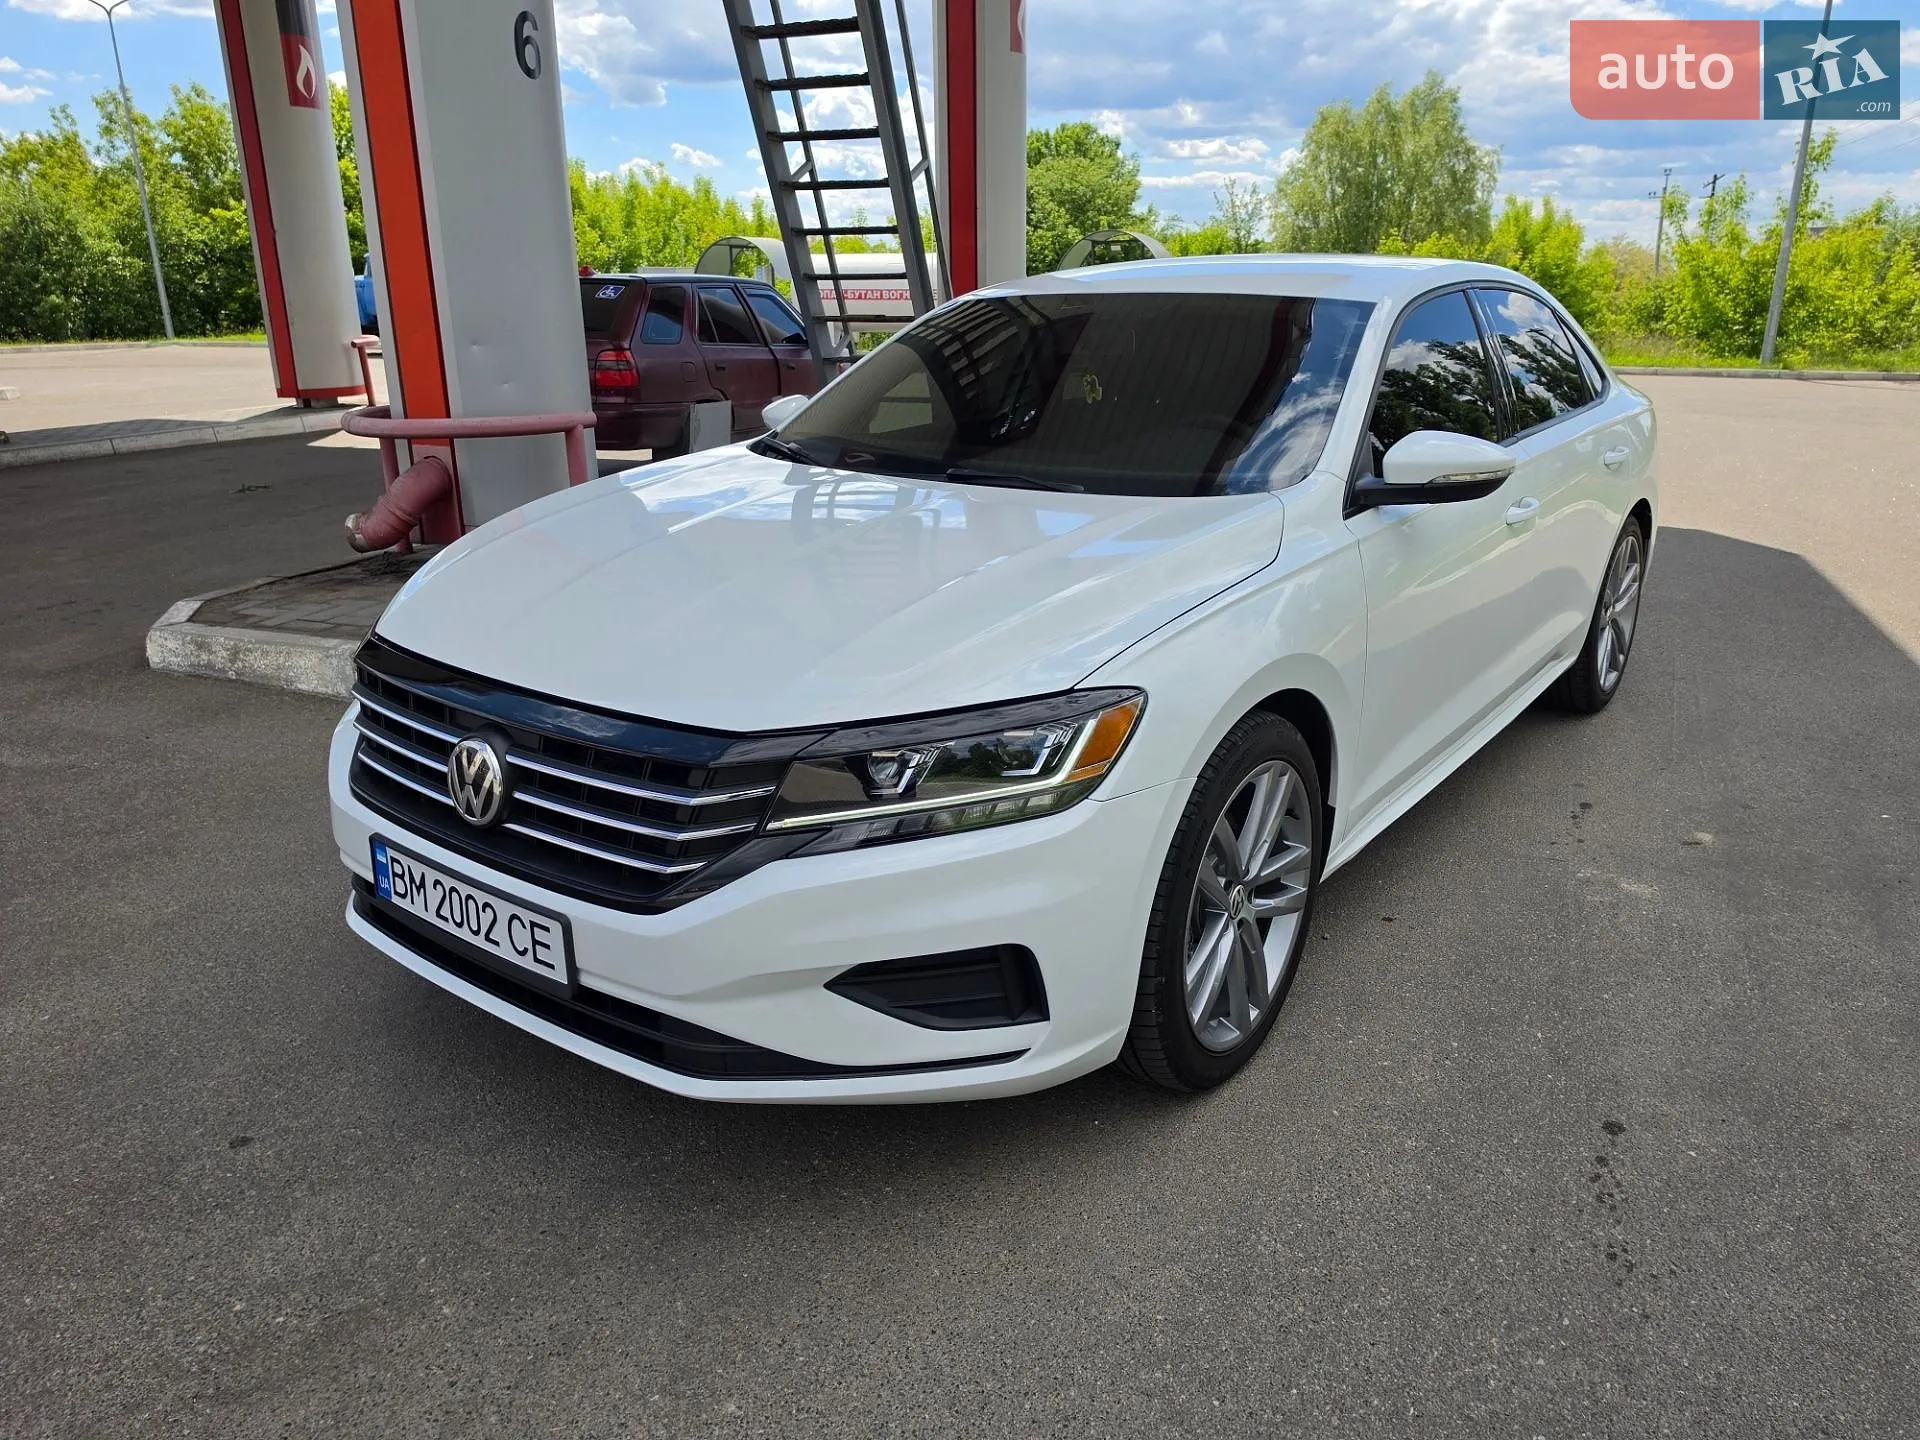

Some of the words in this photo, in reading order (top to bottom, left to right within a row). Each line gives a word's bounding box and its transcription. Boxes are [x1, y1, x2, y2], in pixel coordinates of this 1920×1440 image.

[514, 10, 541, 80] 6
[378, 874, 391, 890] UA
[390, 855, 429, 913] BM
[433, 878, 500, 947] 2002
[507, 913, 555, 971] CE
